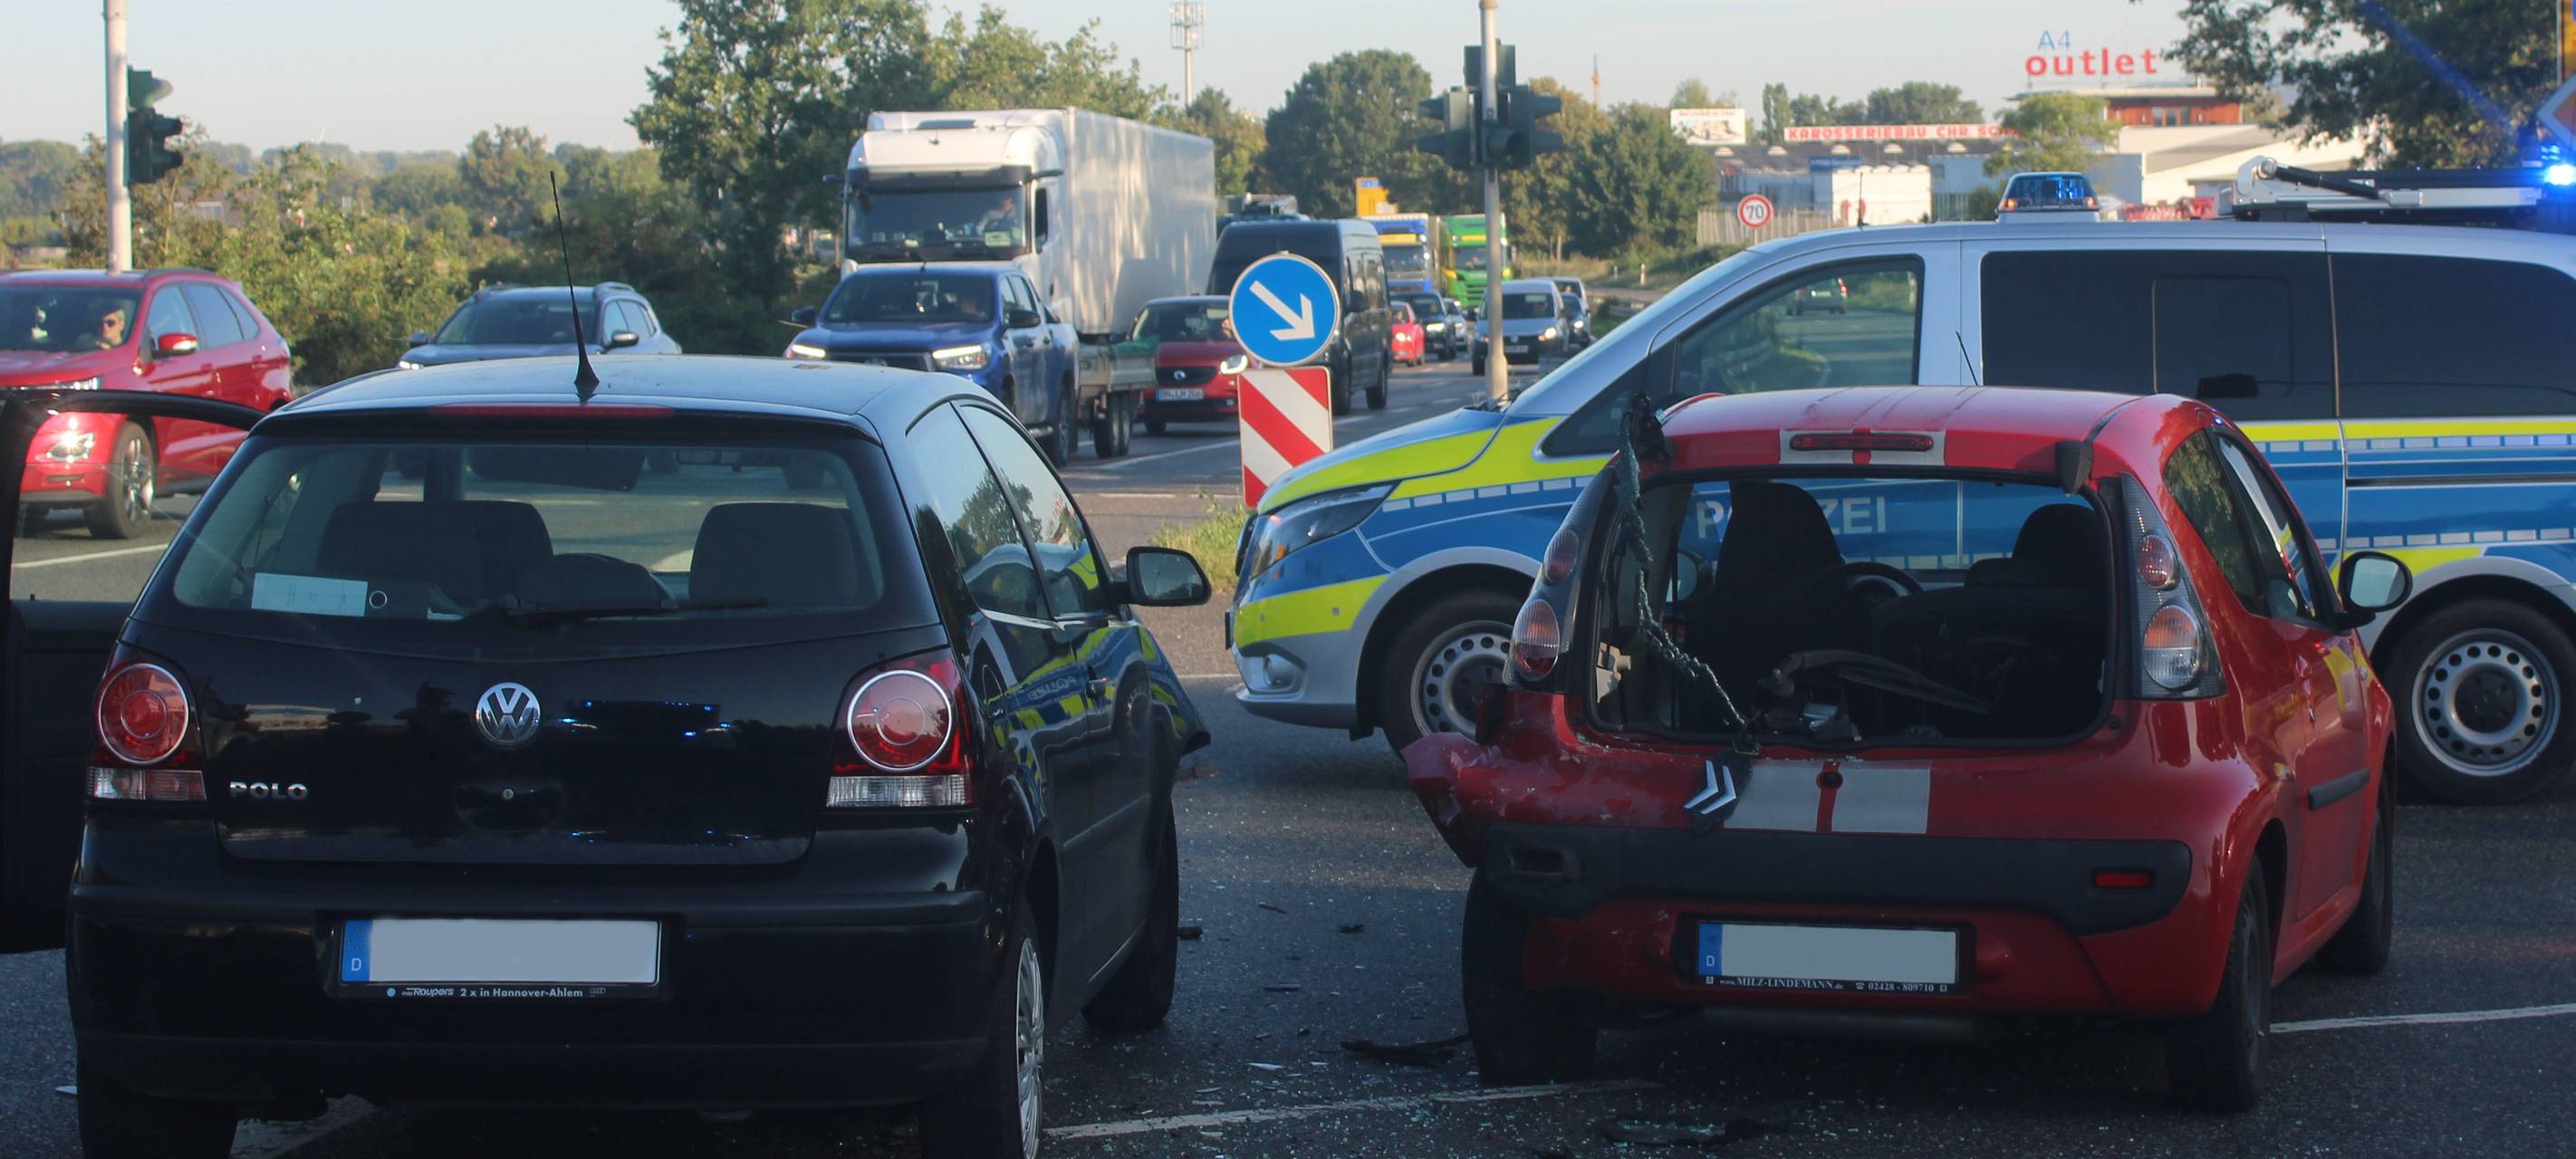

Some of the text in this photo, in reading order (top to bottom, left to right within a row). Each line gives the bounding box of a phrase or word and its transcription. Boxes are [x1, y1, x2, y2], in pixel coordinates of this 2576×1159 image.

[2038, 30, 2071, 50] A4
[2025, 47, 2158, 76] outlet
[1788, 126, 1927, 141] KAROSSERIEBAU
[1746, 204, 1764, 219] 70
[1697, 496, 1887, 540] PZEI
[230, 781, 309, 800] POLO
[351, 957, 362, 972] D
[1706, 955, 1716, 967] D
[459, 988, 467, 997] 2
[470, 989, 477, 997] x
[480, 987, 490, 997] in
[493, 986, 584, 997] Hannover-Ahlem
